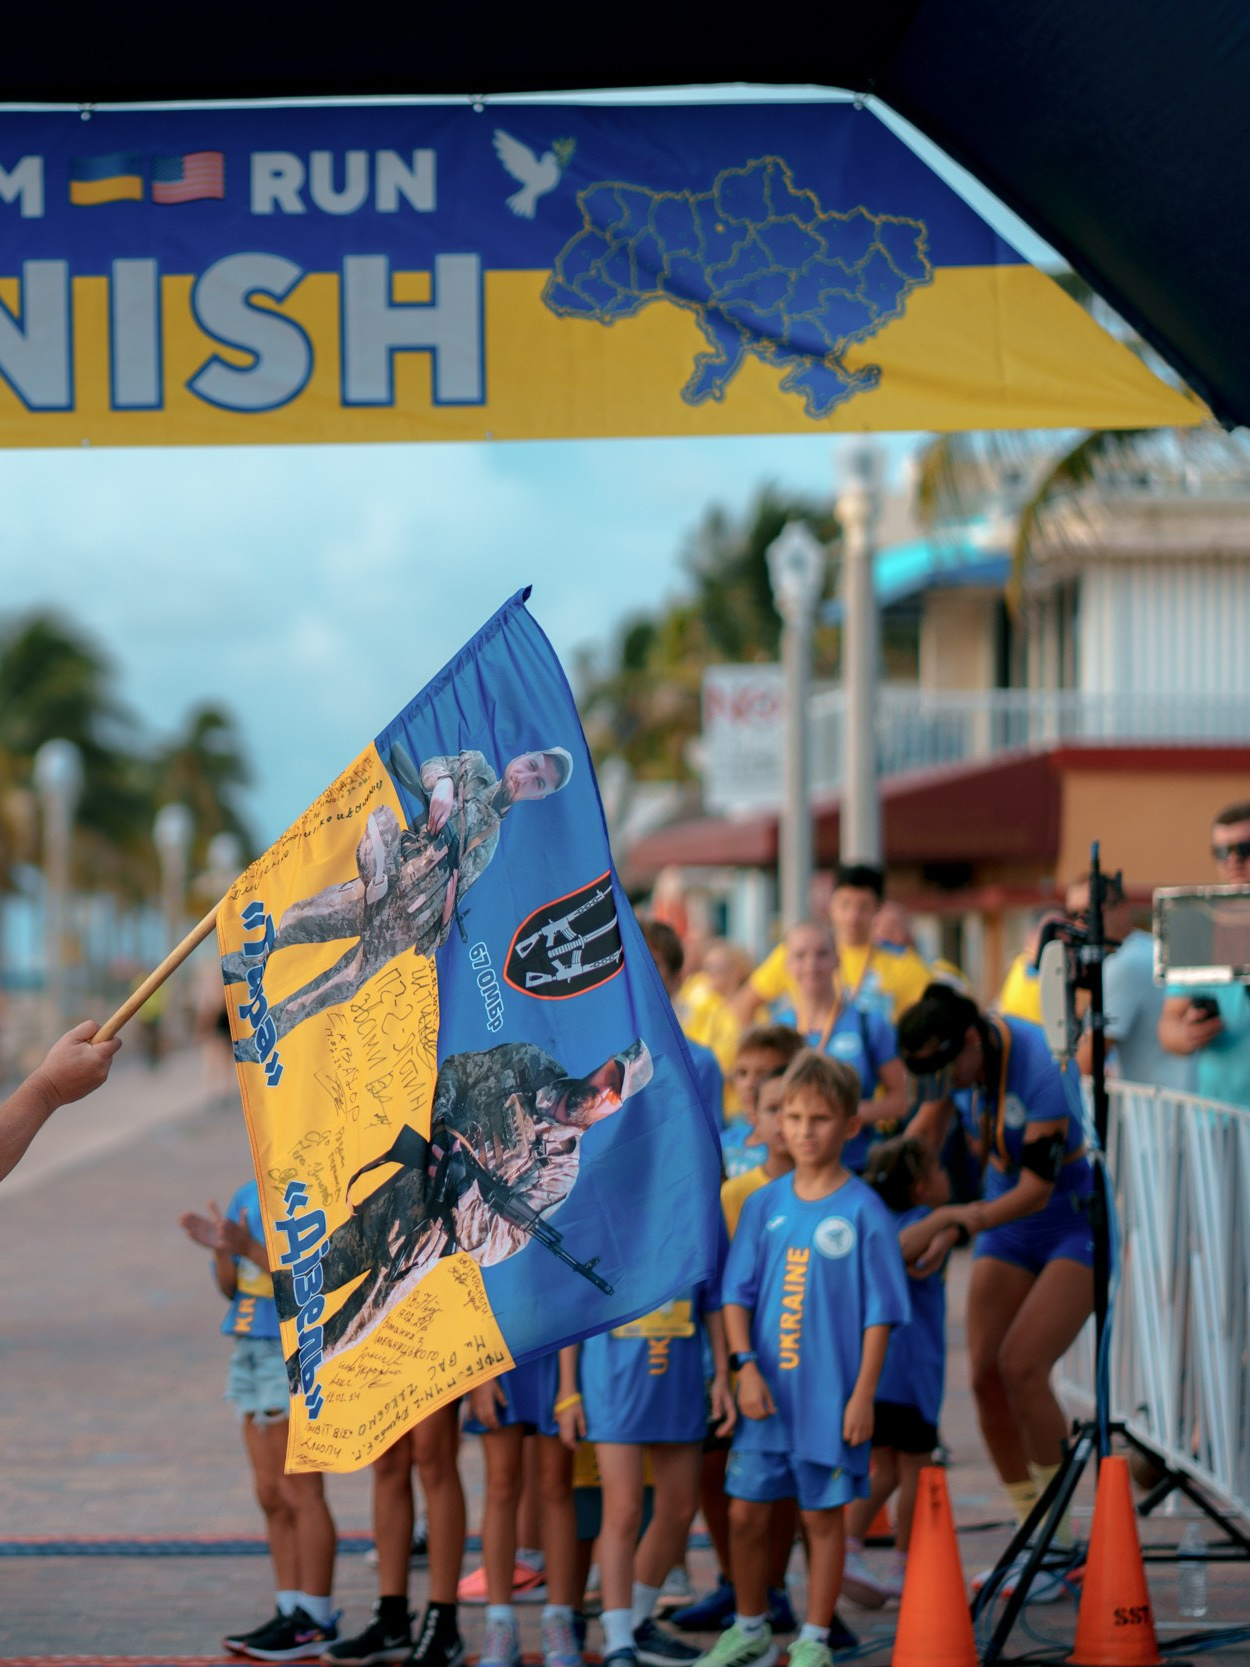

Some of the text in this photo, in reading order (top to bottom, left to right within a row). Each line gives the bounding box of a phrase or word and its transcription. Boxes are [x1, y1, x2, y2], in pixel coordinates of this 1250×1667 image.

[249, 149, 437, 215] RUN
[469, 942, 491, 969] 67
[779, 1247, 811, 1370] UKRAINE
